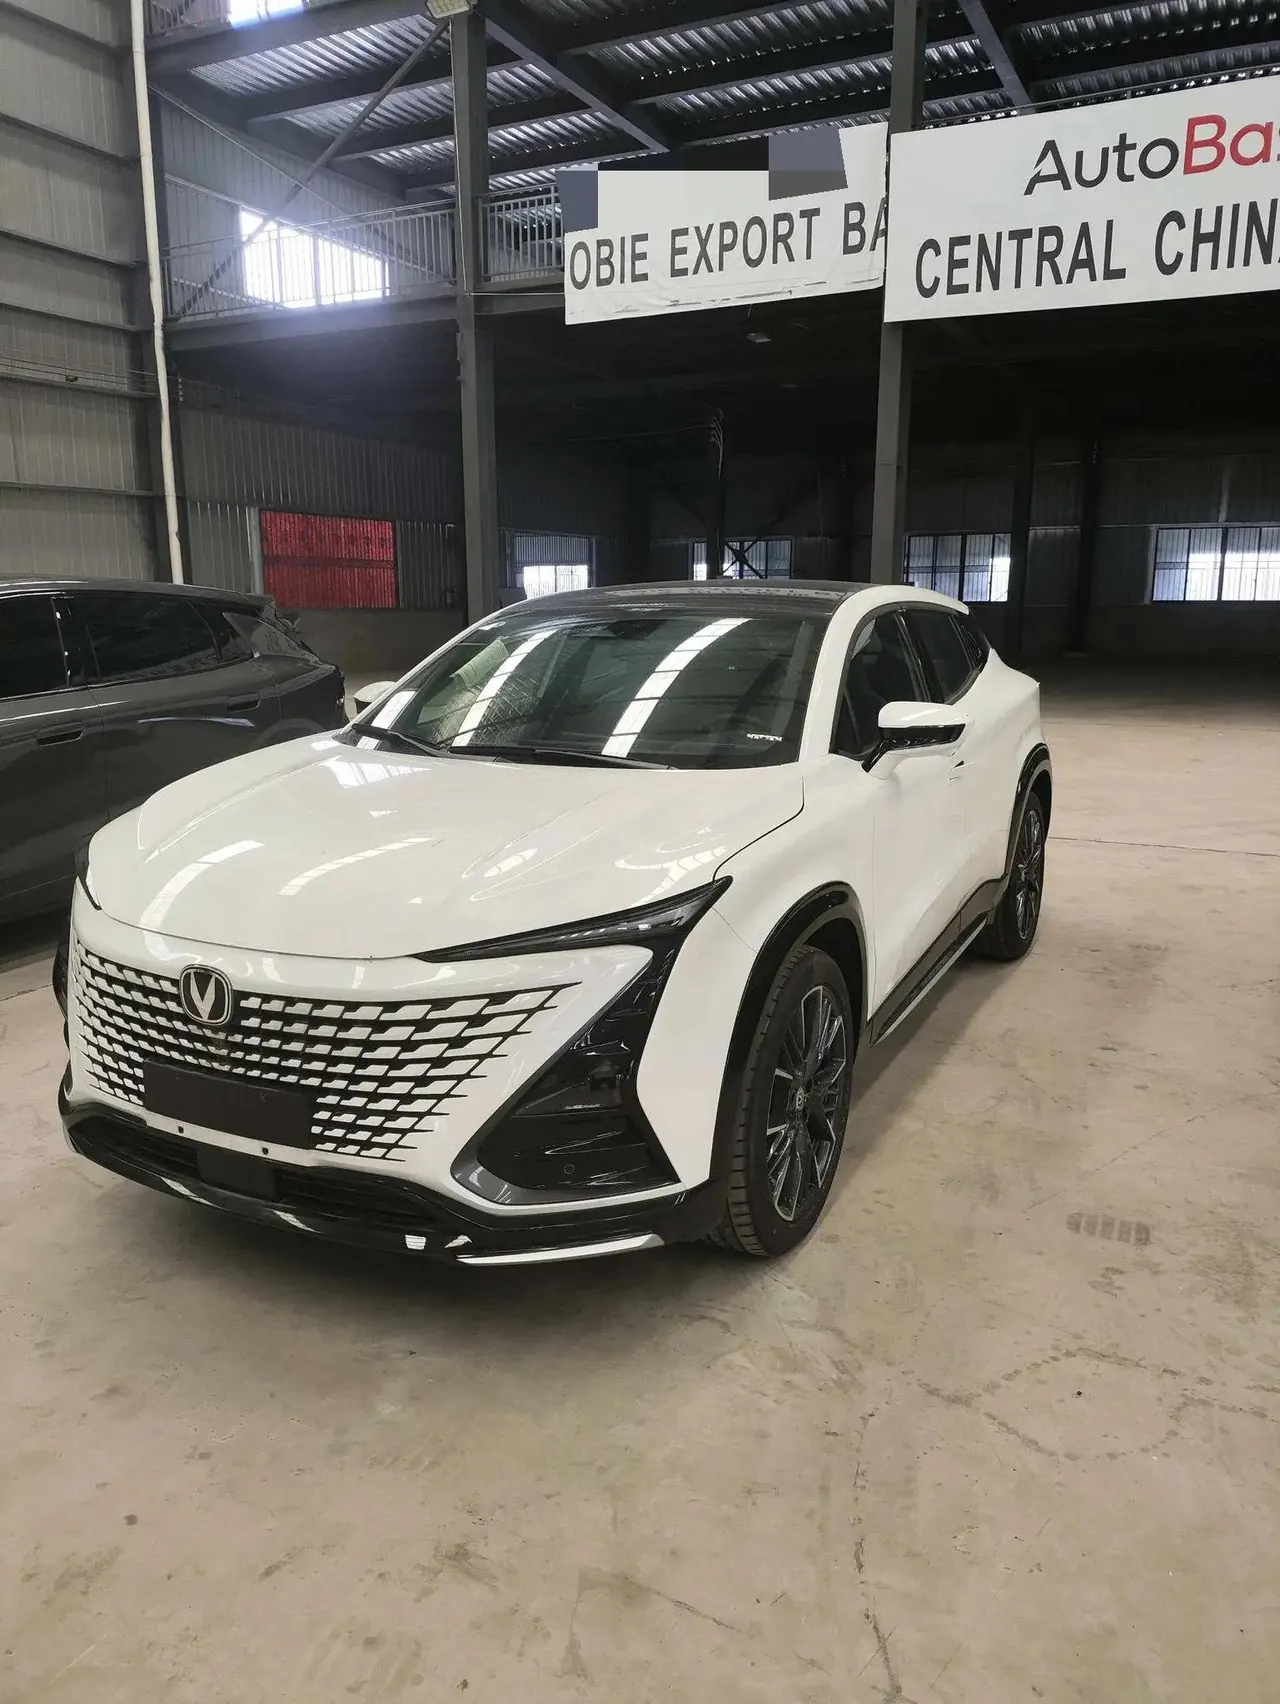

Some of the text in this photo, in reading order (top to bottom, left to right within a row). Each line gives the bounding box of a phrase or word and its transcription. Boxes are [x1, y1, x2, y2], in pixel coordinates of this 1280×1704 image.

[1023, 114, 1280, 196] AutoBa
[570, 233, 649, 290] OBIE
[670, 207, 821, 278] EXPORT
[915, 198, 1280, 298] CENTRAL CHIN
